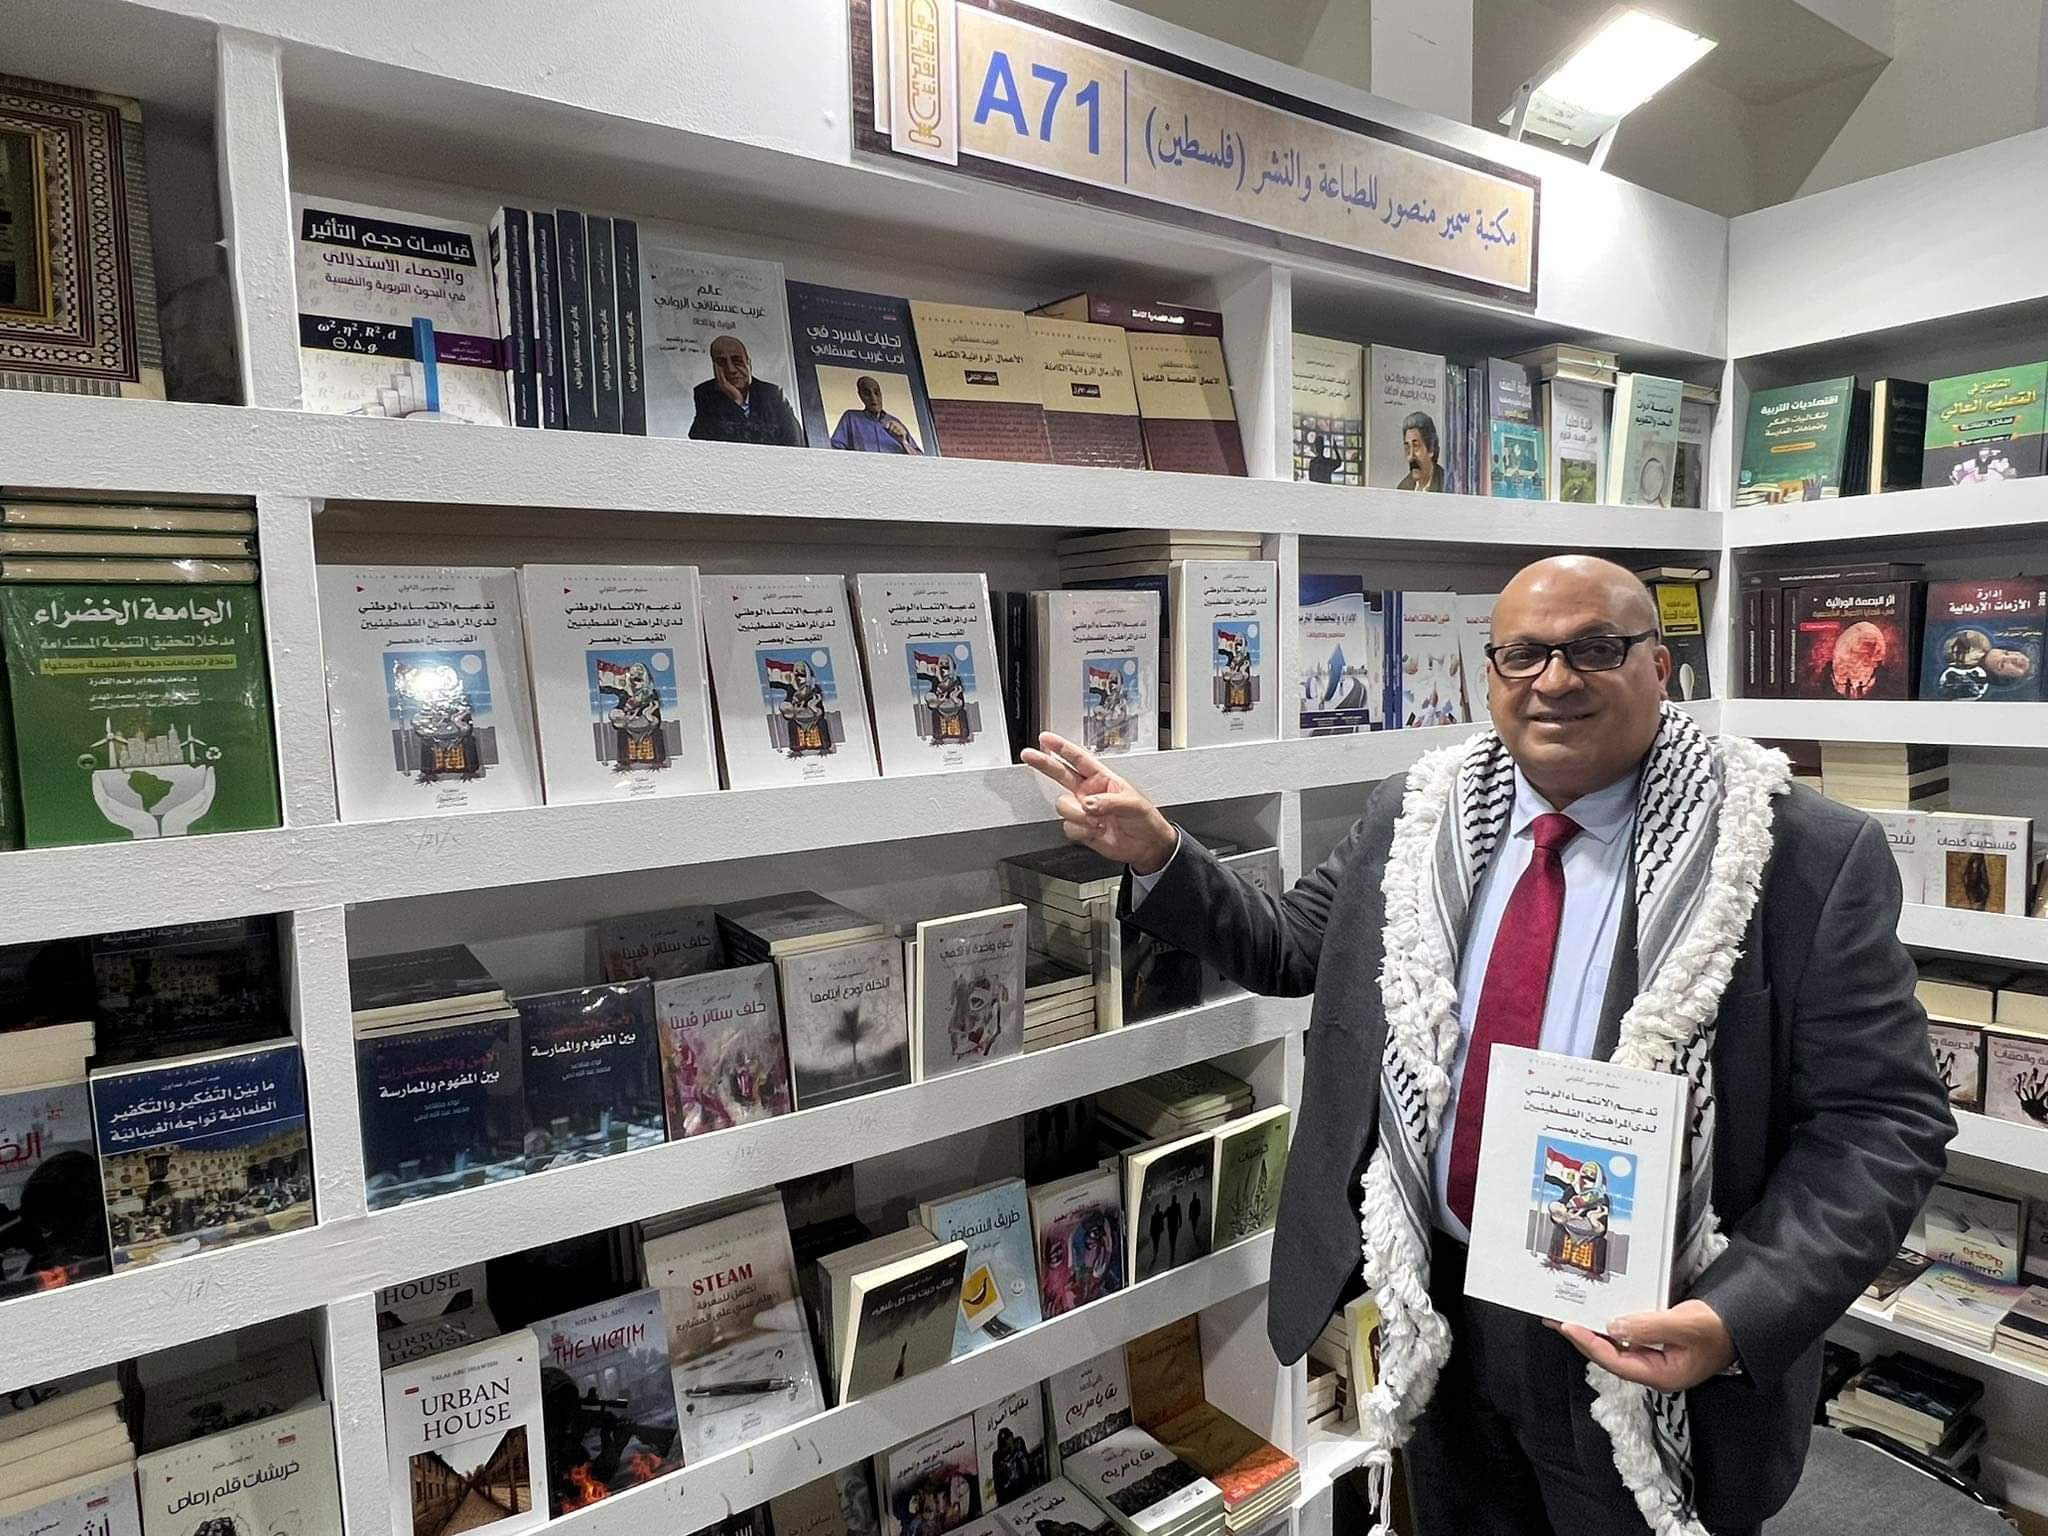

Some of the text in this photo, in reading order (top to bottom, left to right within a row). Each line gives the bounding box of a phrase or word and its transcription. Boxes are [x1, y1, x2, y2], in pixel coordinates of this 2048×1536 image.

[974, 50, 1099, 155] A71
[1145, 106, 1516, 251] مكتبة سمير منصور للطباعة والنشر (فلسطين)
[310, 217, 471, 261] قياسات حجم التأثير
[323, 251, 464, 285] والإحصاء الاستدلالي
[326, 273, 466, 301] في البحوث التربوية والنفسية
[697, 284, 723, 296] عالم
[654, 295, 767, 318] غريب عسقلاني الروائي
[806, 325, 829, 338] في
[831, 328, 864, 344] السرد
[810, 343, 884, 363] غريب عسقلاني
[932, 349, 960, 360] الكاملة
[1043, 362, 1068, 373] الكاملة
[1760, 402, 1790, 416] التربية
[1940, 389, 2036, 421] التعليم العالي
[34, 597, 232, 629] الجامعة الخضراء
[358, 601, 496, 614] تدعيم الانتماء الوطني
[564, 601, 682, 614] تدعيم الانتماء الوطني
[734, 605, 833, 619] تدعيم الانتماء الوطني
[887, 603, 976, 614] تدعيم الانتماء الوطني
[1994, 600, 2031, 612] الأزمات
[427, 616, 475, 629] المراهقين
[475, 617, 497, 628] لدى
[567, 616, 683, 630] لدى المراهقين الفلسطينيين
[737, 619, 836, 632] لدى المراهقين الفلسطينيين
[890, 615, 977, 626] لدى المراهقين الفلسطينيين
[39, 637, 100, 650] المستدامة
[102, 636, 150, 651] التنمية
[588, 633, 667, 645] المقيمين بمصر
[756, 633, 823, 646] المقيمين بمصر
[906, 629, 965, 639] المقيمين بمصر
[670, 1001, 767, 1031] خلف ستائر فيينا
[530, 1032, 636, 1057] بين المفهوم والممارسة
[378, 1070, 500, 1098] بين المفهوم والممارسة
[1525, 1085, 1658, 1117] تدعيم الانتماء الوطني
[1523, 1102, 1657, 1133] لدى المراهقين الفلسطينيين
[1542, 1123, 1633, 1146] المقيمين بمصر
[994, 1209, 1021, 1230] طريق
[382, 1272, 461, 1306] HOUSE
[692, 1263, 753, 1296] STEAM
[553, 1322, 646, 1366] THE VICTIM
[421, 1377, 511, 1417] URBAN
[1065, 1398, 1095, 1424] مريم
[423, 1401, 512, 1442] HOUSE
[167, 1459, 301, 1516] خربشات قلم رصاص
